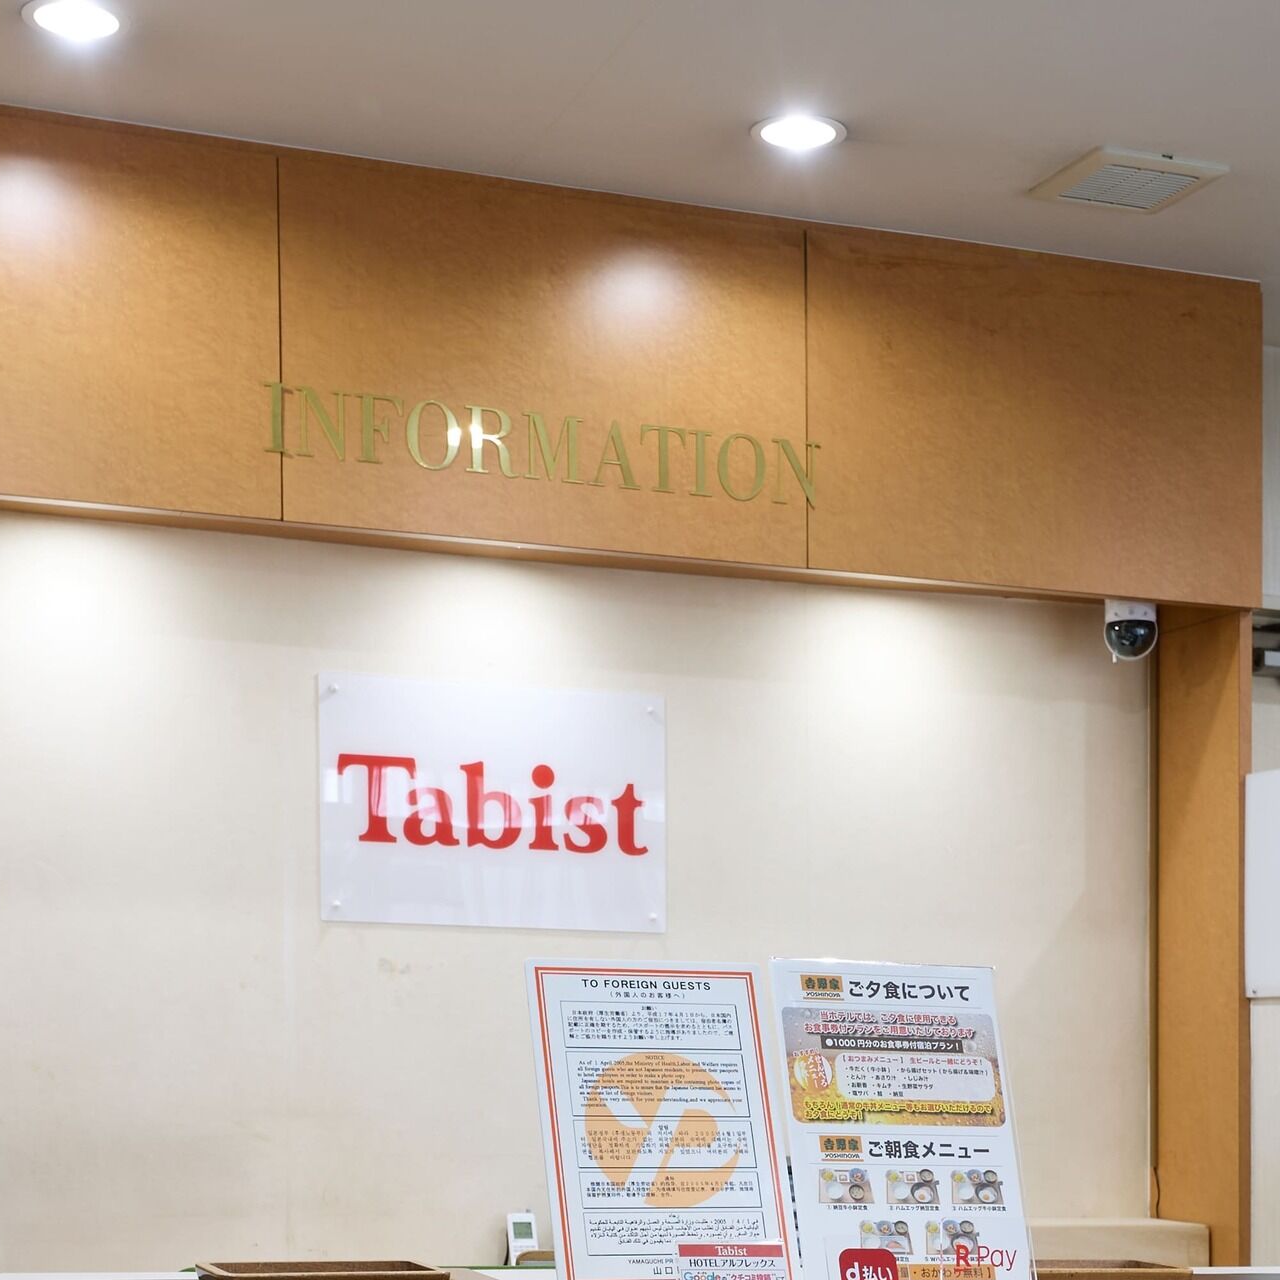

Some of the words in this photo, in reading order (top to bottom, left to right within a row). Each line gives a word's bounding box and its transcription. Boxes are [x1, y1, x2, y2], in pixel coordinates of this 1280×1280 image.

[263, 381, 820, 509] INFORMATION
[337, 753, 649, 856] Tabist
[581, 978, 598, 988] TO
[603, 979, 657, 990] FOREIGN
[662, 981, 711, 991] GUESTS
[848, 980, 970, 1002] ご夕食について
[868, 1140, 990, 1159] ご朝食メニュー
[714, 1246, 749, 1256] Tabist
[977, 1245, 1017, 1271] Pay
[689, 1258, 776, 1268] HOTELアルフレックス
